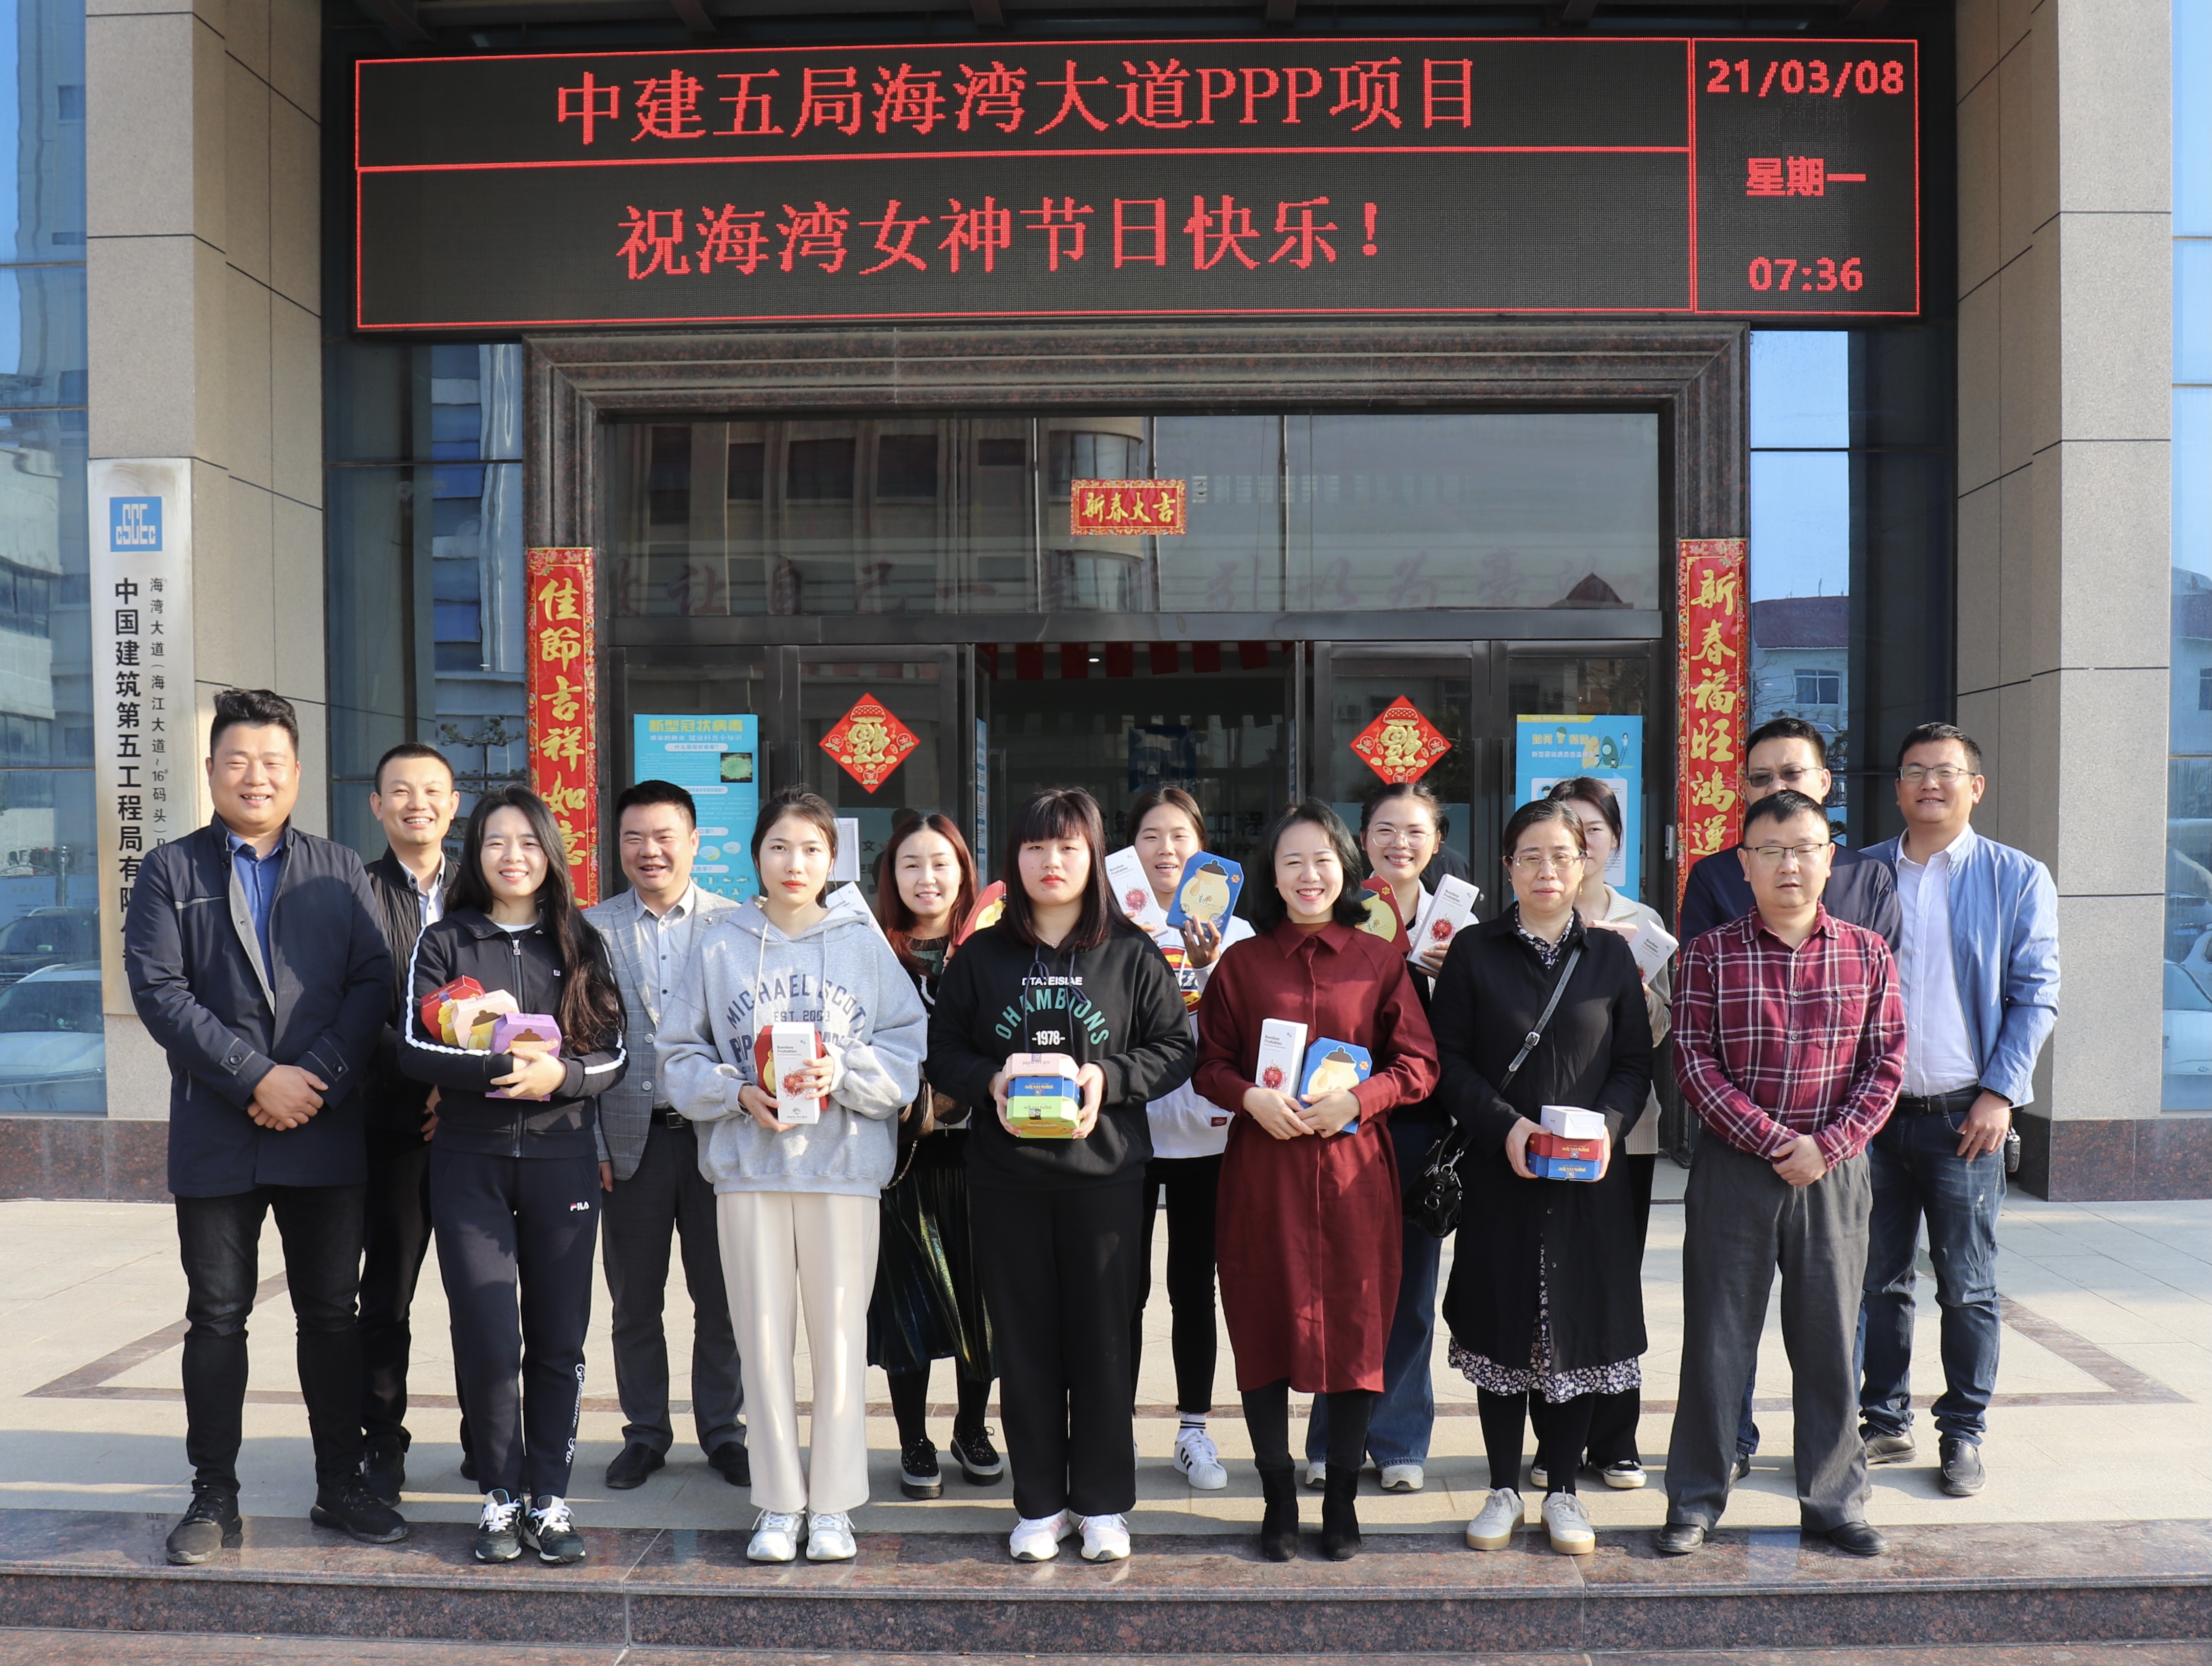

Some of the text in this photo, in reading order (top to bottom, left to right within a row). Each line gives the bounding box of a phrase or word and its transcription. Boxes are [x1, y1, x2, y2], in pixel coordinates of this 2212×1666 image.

[1707, 58, 1904, 98] 21/03/08
[558, 57, 1473, 145] 中建五局海湾大道PPP项目
[1746, 156, 1867, 196] 星期一
[1749, 257, 1864, 292] 07:36
[1081, 492, 1176, 523] 新春大吉
[727, 974, 811, 1030] MICHAEL
[773, 1011, 799, 1022] EST.
[569, 1200, 590, 1212] FILA
